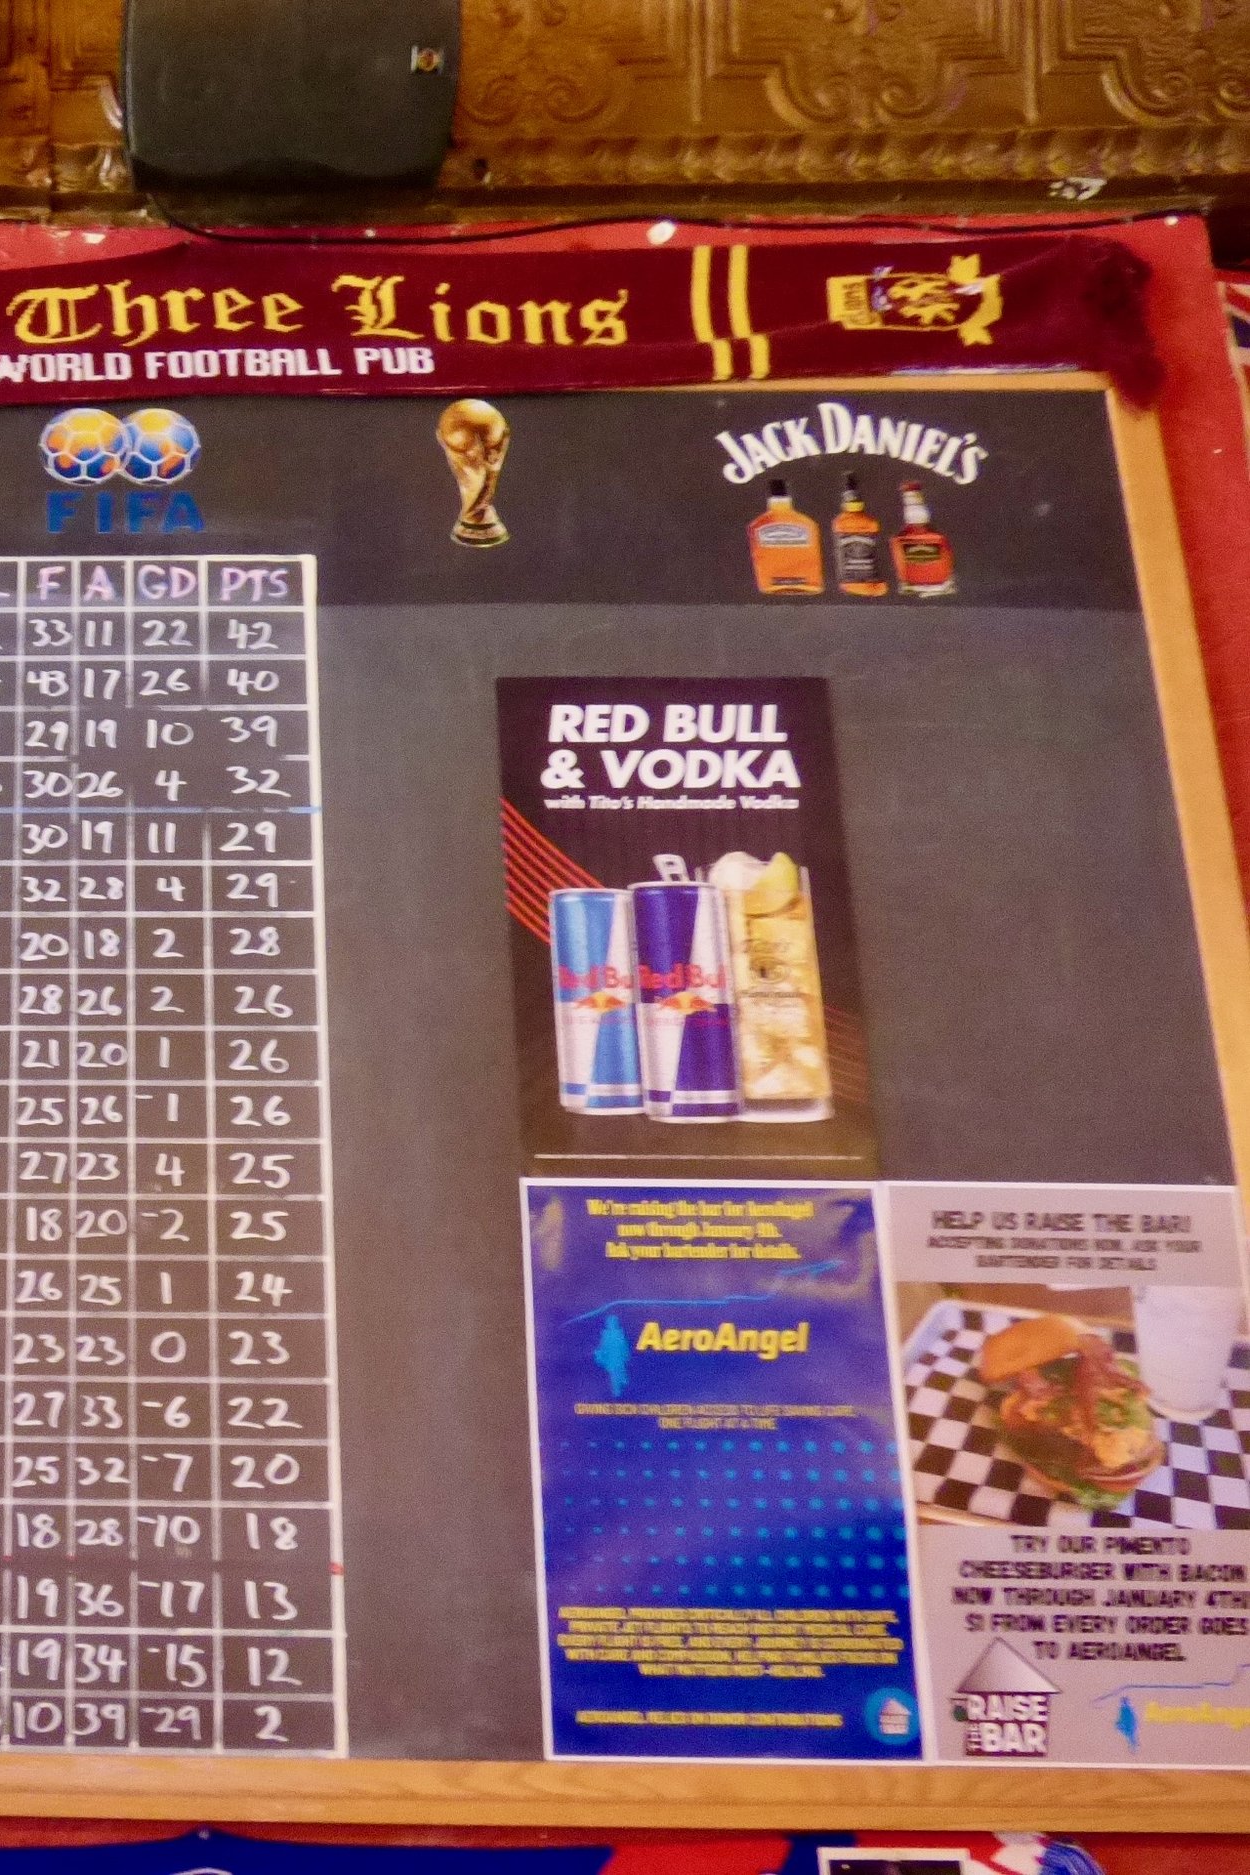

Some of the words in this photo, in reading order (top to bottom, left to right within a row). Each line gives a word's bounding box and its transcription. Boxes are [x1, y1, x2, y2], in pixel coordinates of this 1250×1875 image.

[6, 279, 304, 347] Three
[331, 274, 630, 346] Lions
[145, 347, 342, 380] FOOTBALL
[355, 346, 435, 375] PUB
[714, 416, 818, 485] JACK
[816, 402, 988, 484] DANIEL'S
[45, 490, 204, 534] FIFA
[38, 565, 65, 600] F
[84, 567, 115, 602] A
[137, 565, 197, 600] GD
[220, 566, 289, 600] PTS
[28, 617, 73, 647] 33
[84, 620, 114, 648] 11
[142, 618, 193, 649] 22
[227, 619, 279, 650] 42
[227, 667, 280, 695] 40
[220, 716, 278, 748] 39
[548, 704, 650, 743] RED
[663, 704, 788, 743] BULL
[226, 765, 292, 798] 32
[540, 749, 585, 789] &
[601, 749, 801, 789] VODKA
[219, 821, 277, 854] 29
[226, 872, 279, 908] 29
[230, 926, 281, 957] 28
[234, 984, 294, 1018] 26
[229, 1039, 291, 1073] 26
[229, 1094, 292, 1127] 26
[229, 1152, 295, 1188] 25
[229, 1211, 289, 1241] 25
[931, 1211, 985, 1230] HELP
[235, 1271, 292, 1307] 24
[228, 1331, 290, 1365] 23
[637, 1322, 810, 1361] AeroAngel
[227, 1398, 303, 1430] 22
[232, 1454, 301, 1489] 20
[246, 1512, 299, 1551] 18
[244, 1581, 299, 1621] 13
[249, 1647, 303, 1687] 12
[11, 1700, 63, 1735] 10
[73, 1702, 126, 1741] 39
[254, 1705, 289, 1743] 2
[967, 1695, 1048, 1721] RAISE
[980, 1723, 1047, 1752] BAR
